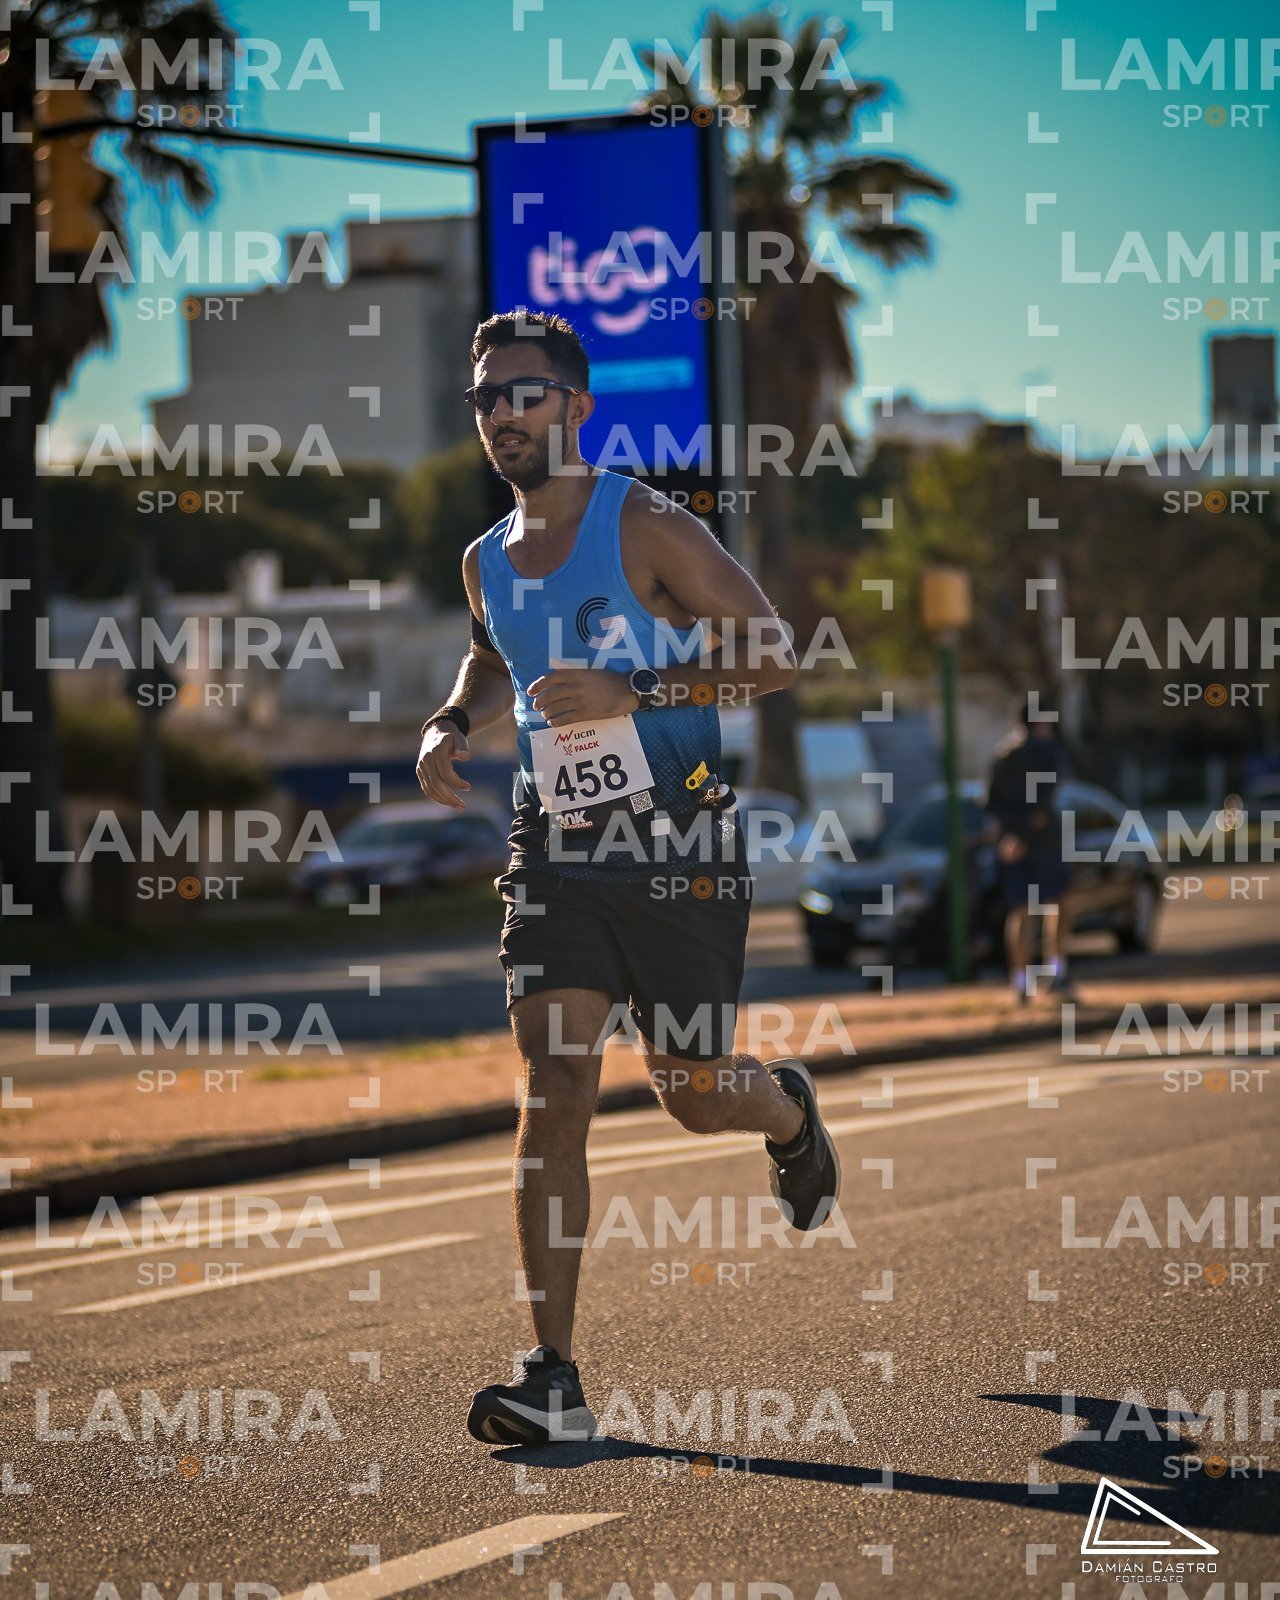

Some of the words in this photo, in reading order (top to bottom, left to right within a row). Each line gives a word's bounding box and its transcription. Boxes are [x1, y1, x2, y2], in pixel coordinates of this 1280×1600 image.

[574, 729, 595, 740] ucm
[574, 740, 600, 752] FALCK
[554, 754, 628, 802] 458
